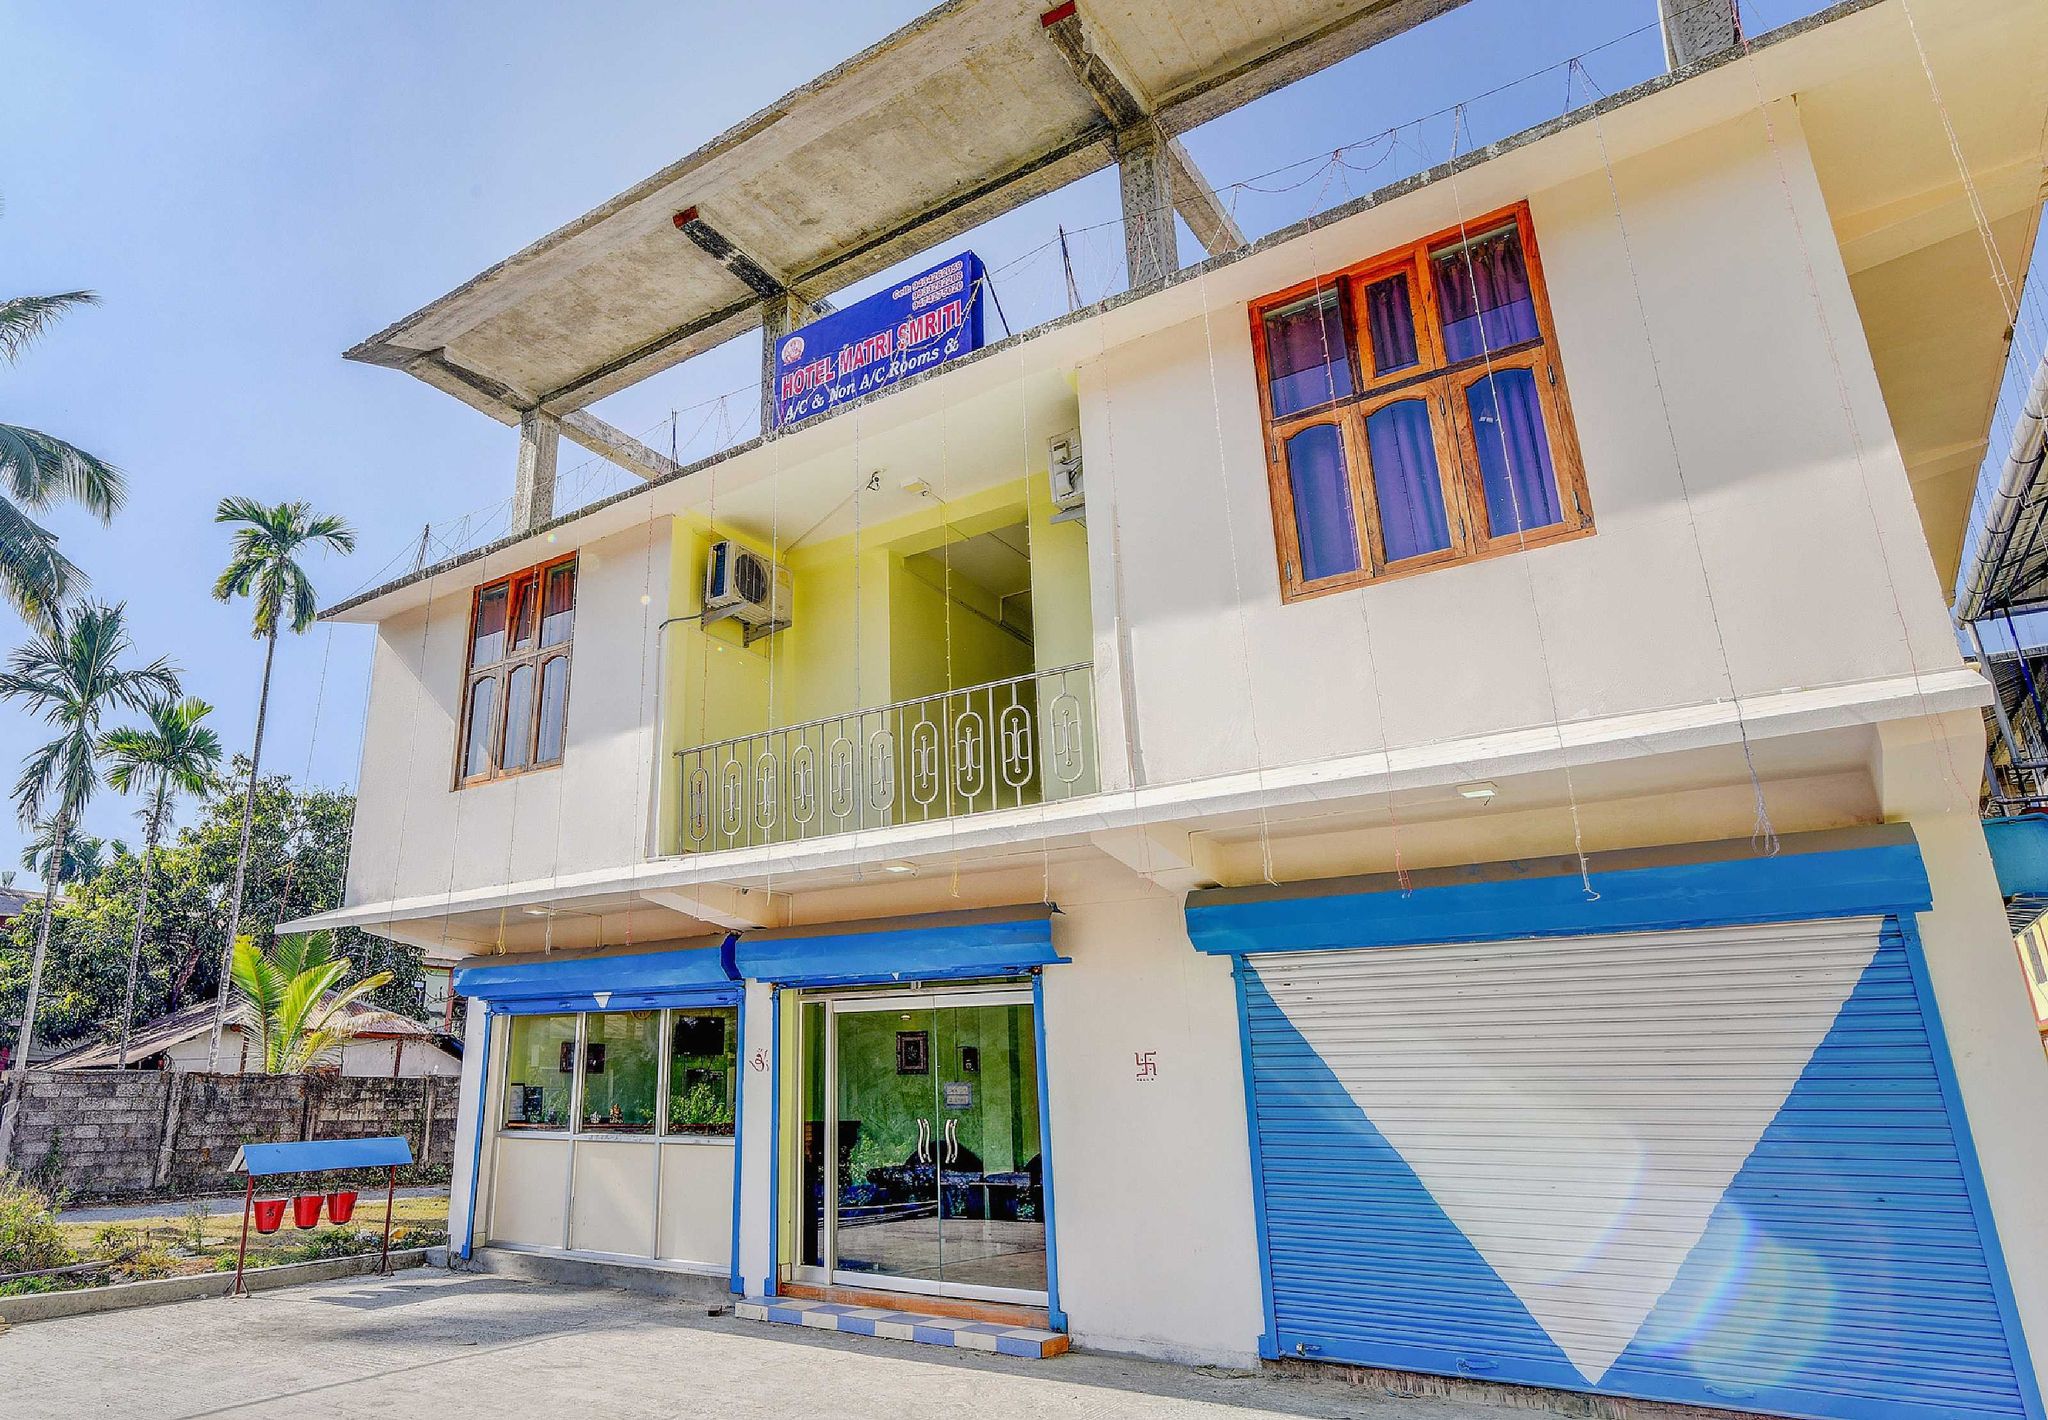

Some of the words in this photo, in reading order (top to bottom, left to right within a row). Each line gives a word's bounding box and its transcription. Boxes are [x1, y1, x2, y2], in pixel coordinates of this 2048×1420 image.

[781, 357, 835, 400] HOTEL
[838, 329, 892, 375] MATRI
[897, 300, 962, 350] SMRITI
[784, 400, 808, 424] A/C
[811, 393, 825, 409] &
[829, 383, 856, 403] Non
[859, 366, 886, 389] A/C
[888, 347, 939, 378] Rooms
[943, 338, 959, 355] &
